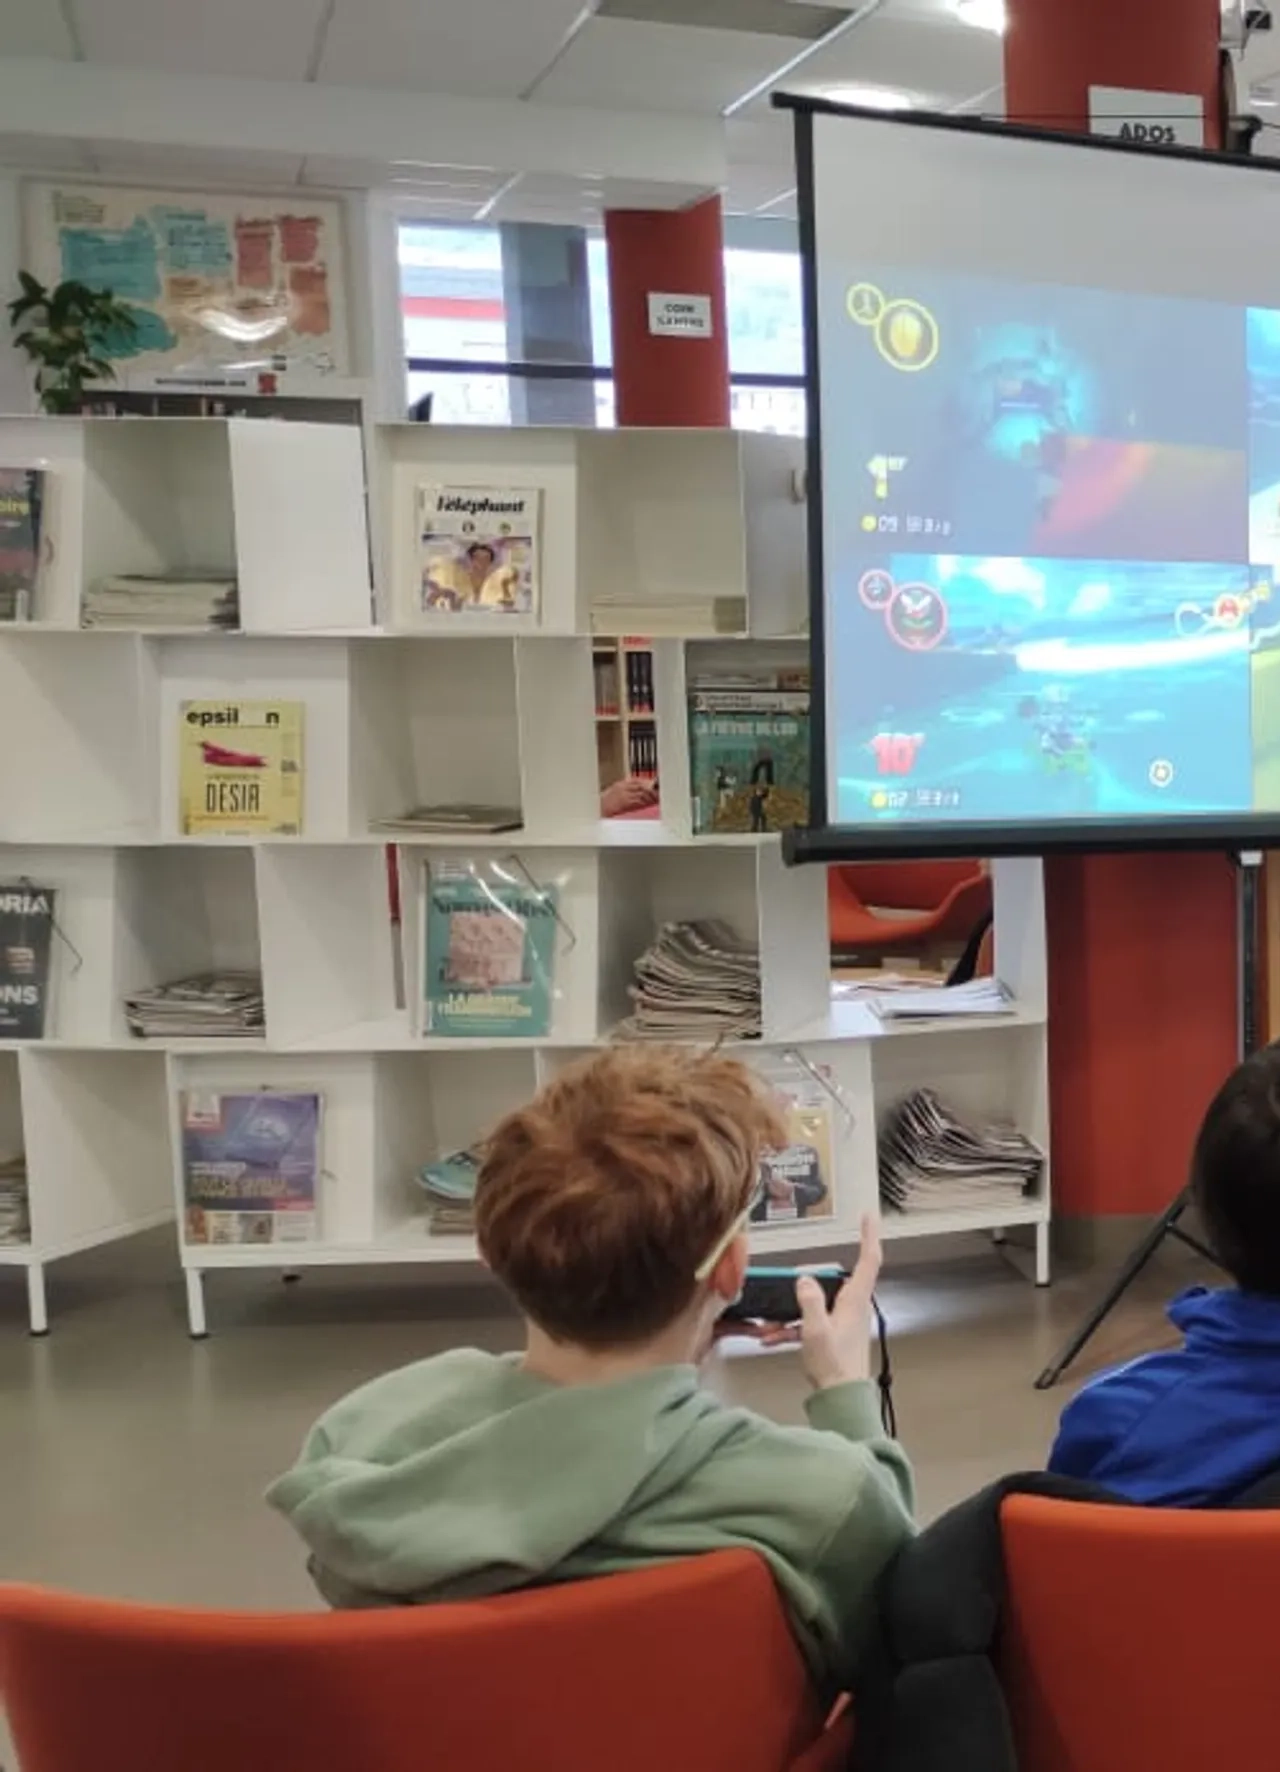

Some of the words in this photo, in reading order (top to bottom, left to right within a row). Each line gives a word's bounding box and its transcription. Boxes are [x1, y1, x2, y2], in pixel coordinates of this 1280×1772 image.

[1119, 122, 1175, 142] ADOS
[186, 707, 280, 728] epsiln
[0, 985, 39, 1005] NS
